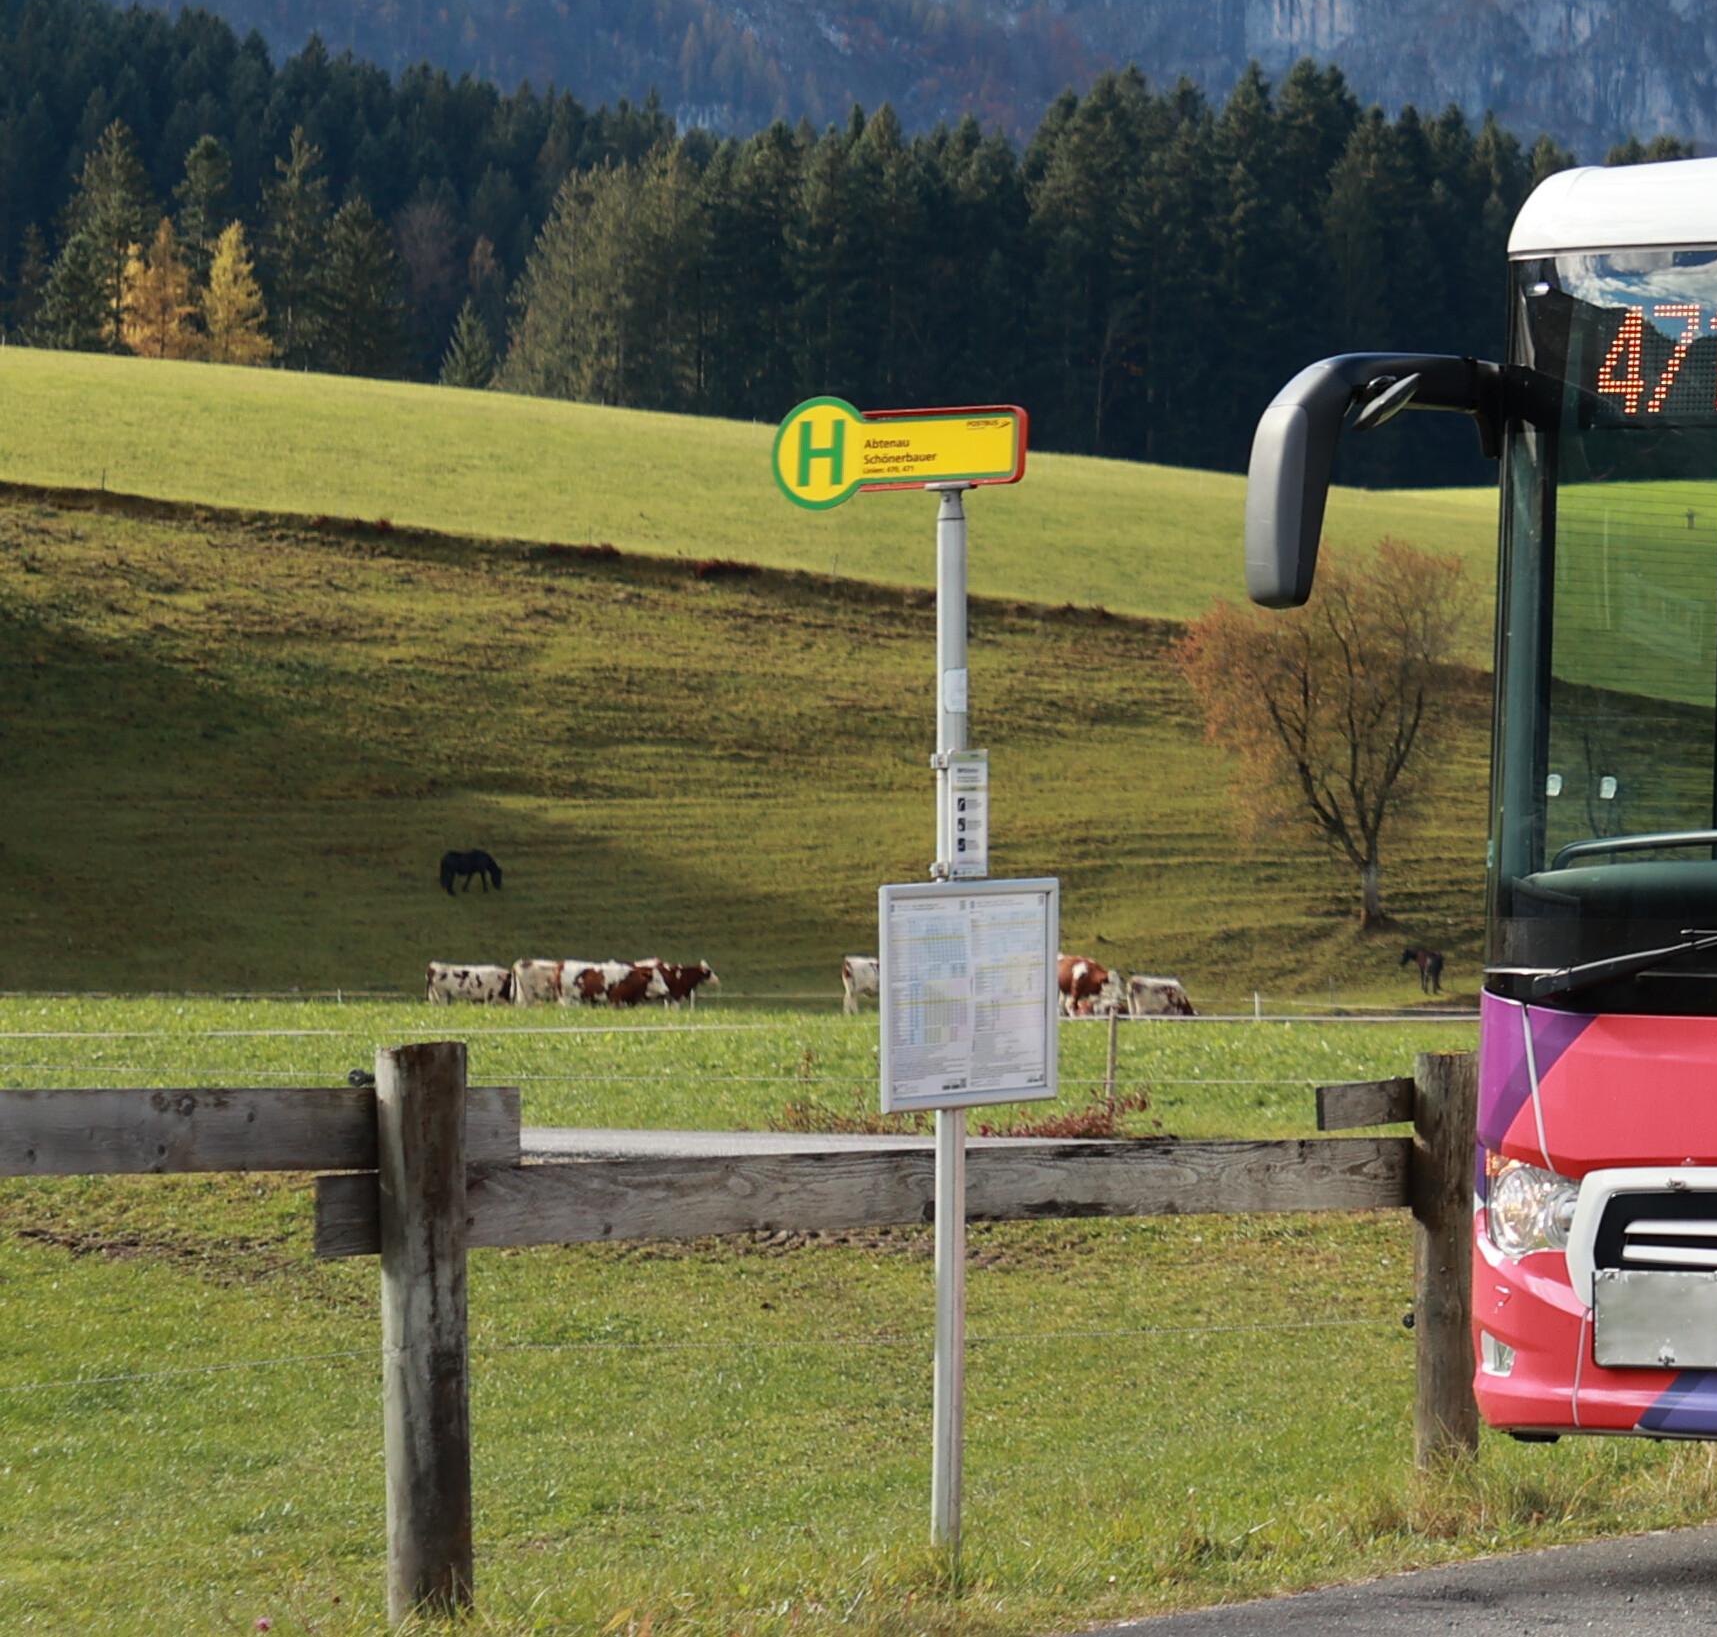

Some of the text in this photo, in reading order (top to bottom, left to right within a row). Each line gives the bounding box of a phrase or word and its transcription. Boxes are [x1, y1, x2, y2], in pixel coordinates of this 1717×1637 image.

[864, 439, 910, 450] Abtenau
[797, 419, 846, 487] H
[863, 452, 938, 465] Schönerbauer
